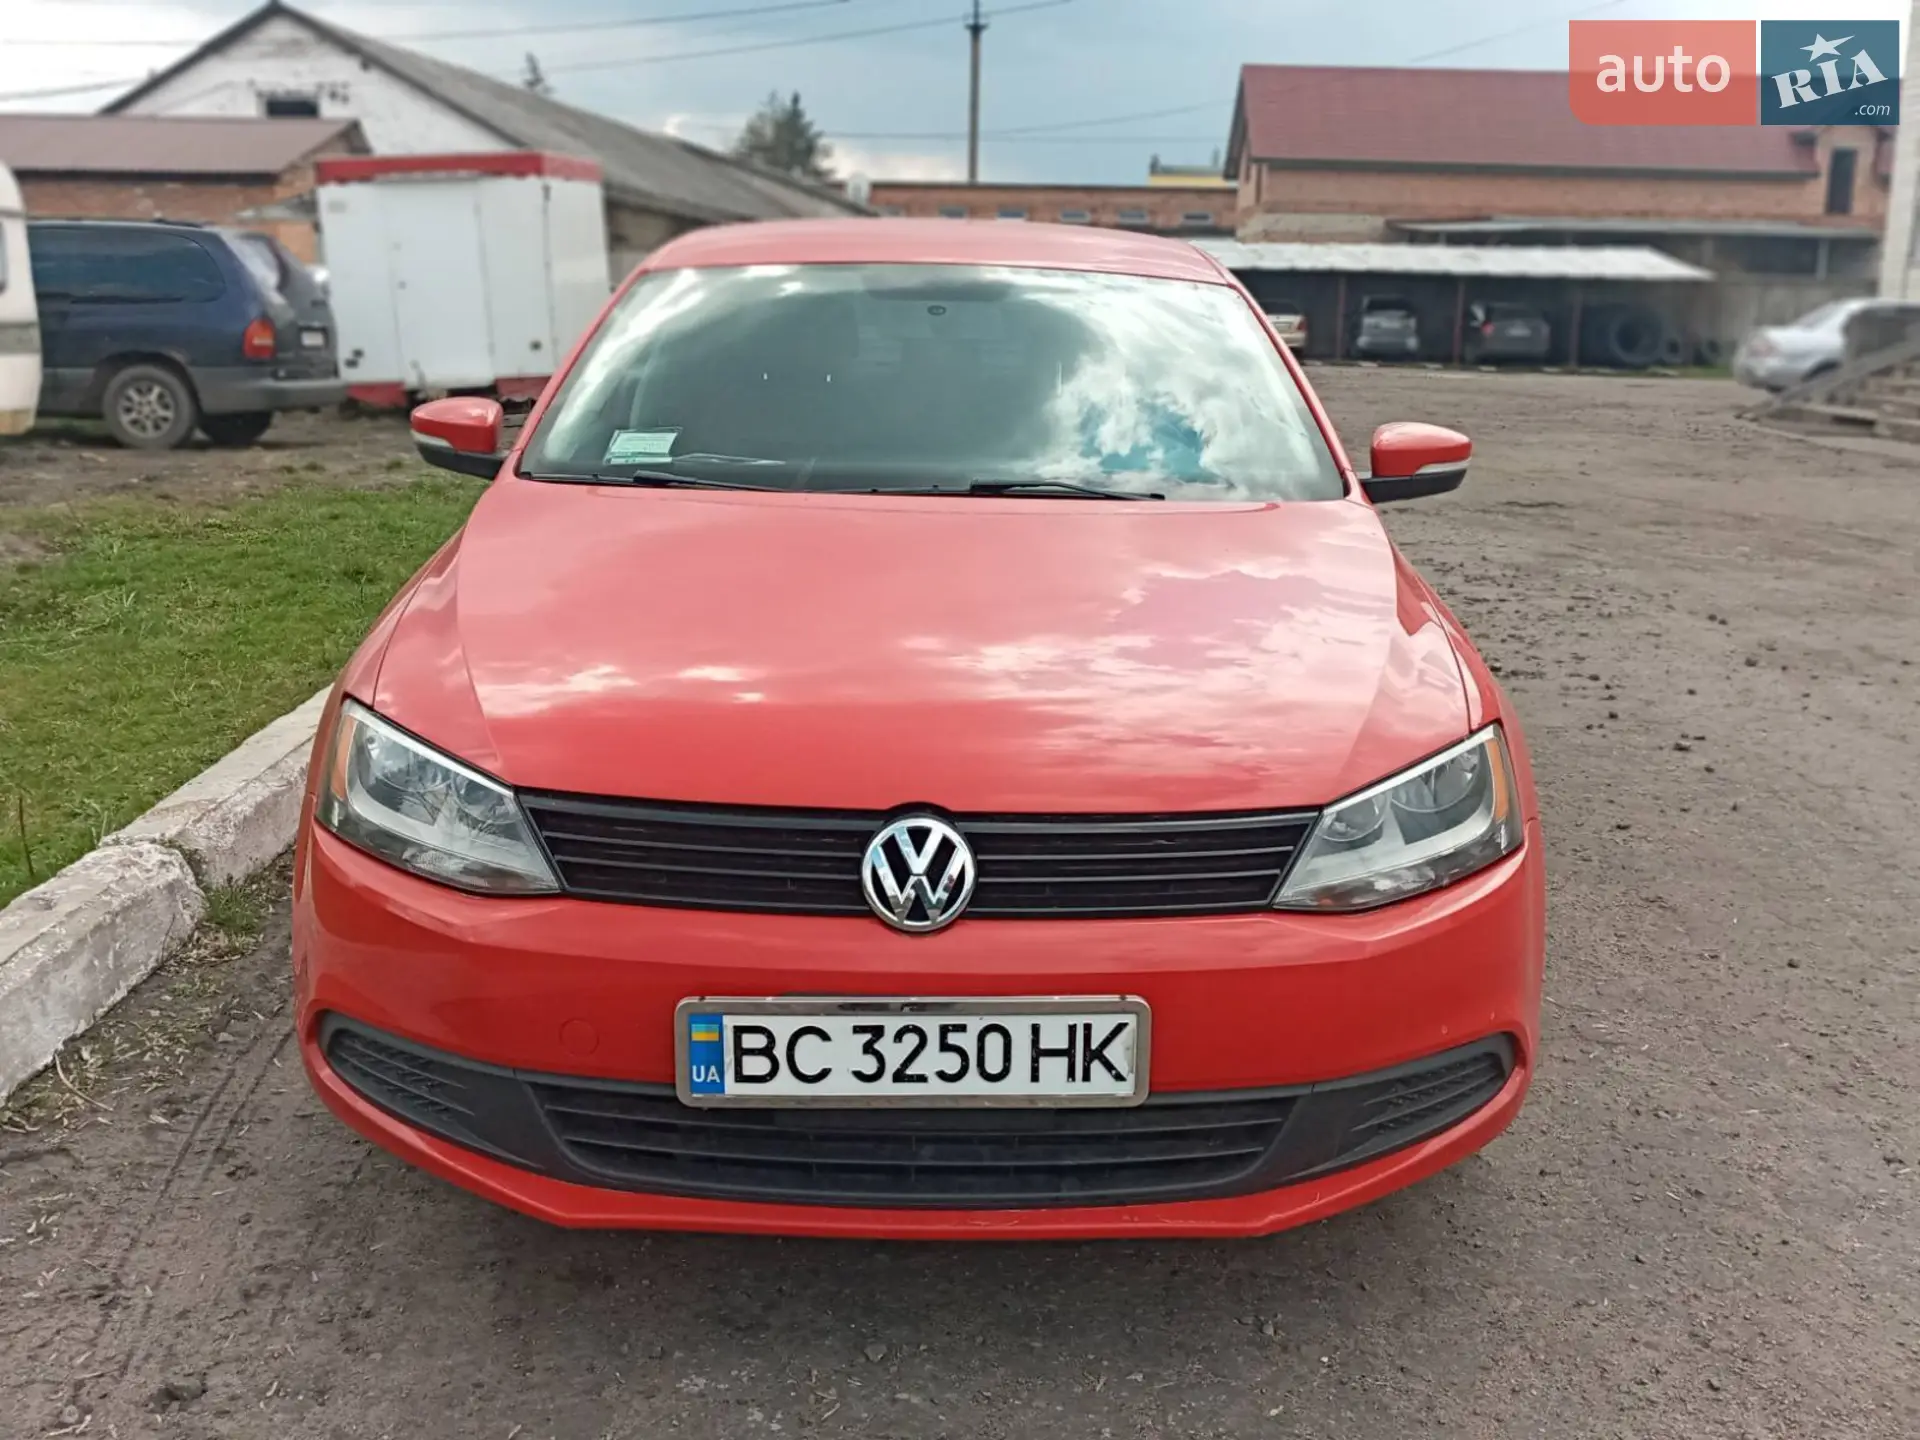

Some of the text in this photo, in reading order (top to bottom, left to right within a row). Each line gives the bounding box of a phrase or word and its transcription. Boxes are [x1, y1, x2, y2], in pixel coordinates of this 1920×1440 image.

[732, 1022, 1129, 1084] BC 3250 HK
[692, 1065, 720, 1084] UA
